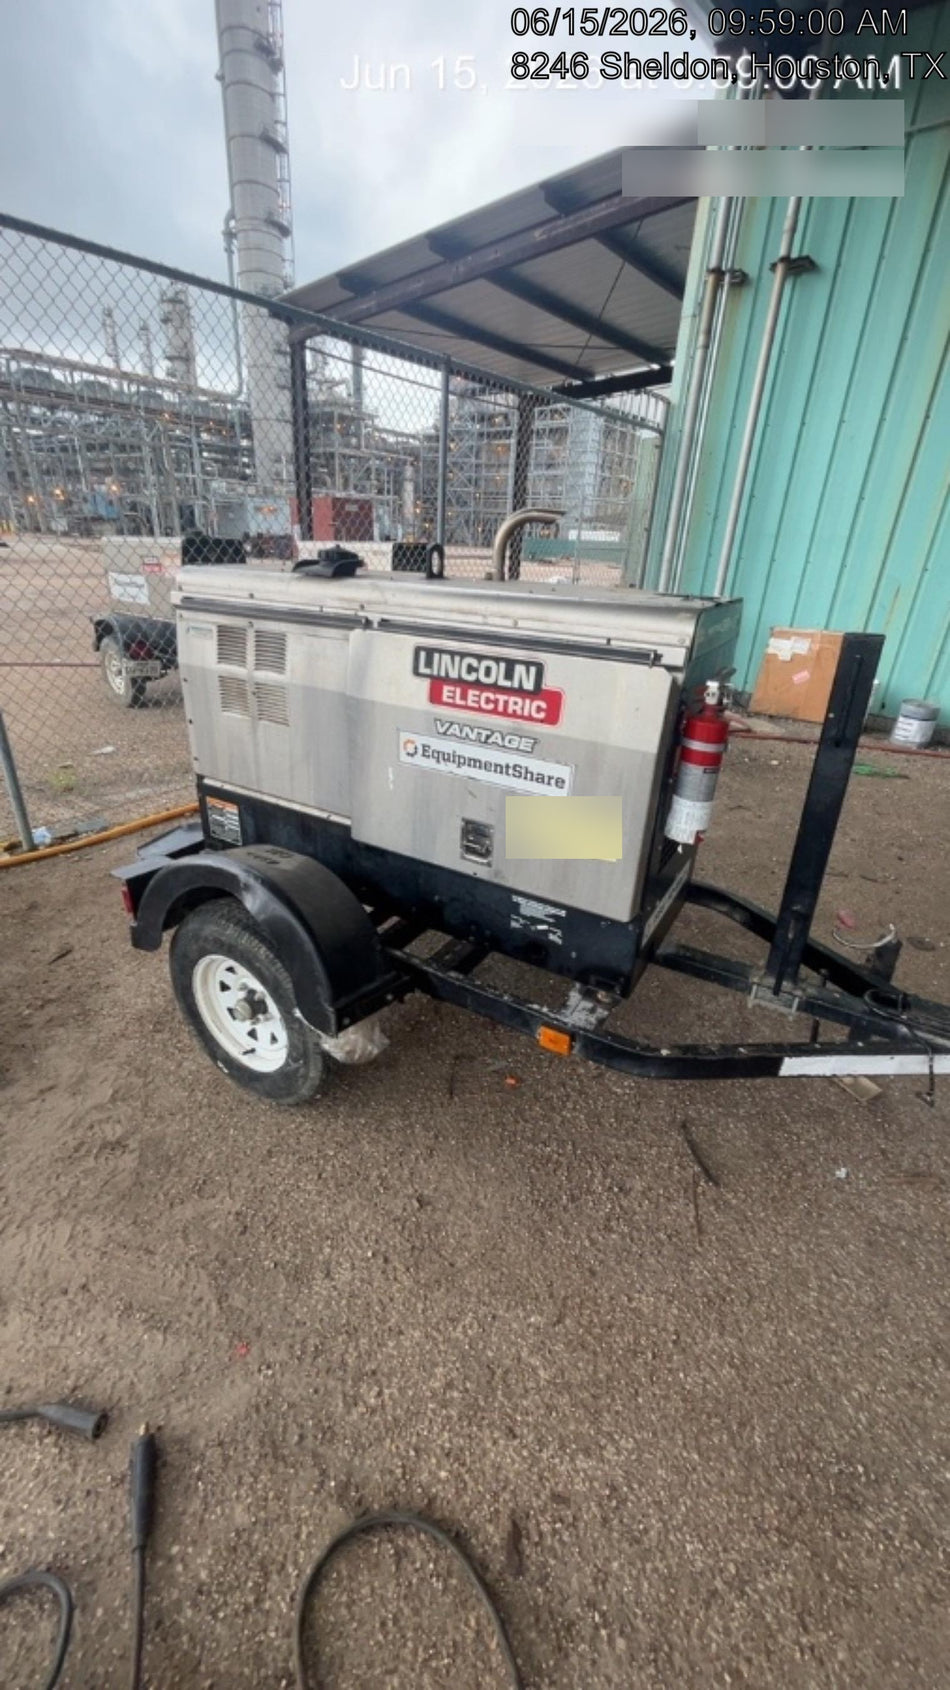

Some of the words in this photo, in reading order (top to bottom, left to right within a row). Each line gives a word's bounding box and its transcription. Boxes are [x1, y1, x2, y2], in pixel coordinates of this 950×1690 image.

[417, 650, 537, 692] LINCOLN
[441, 684, 548, 720] ELECTRIC
[434, 719, 540, 753] VANTAGE
[420, 743, 567, 790] EquipmentShare
